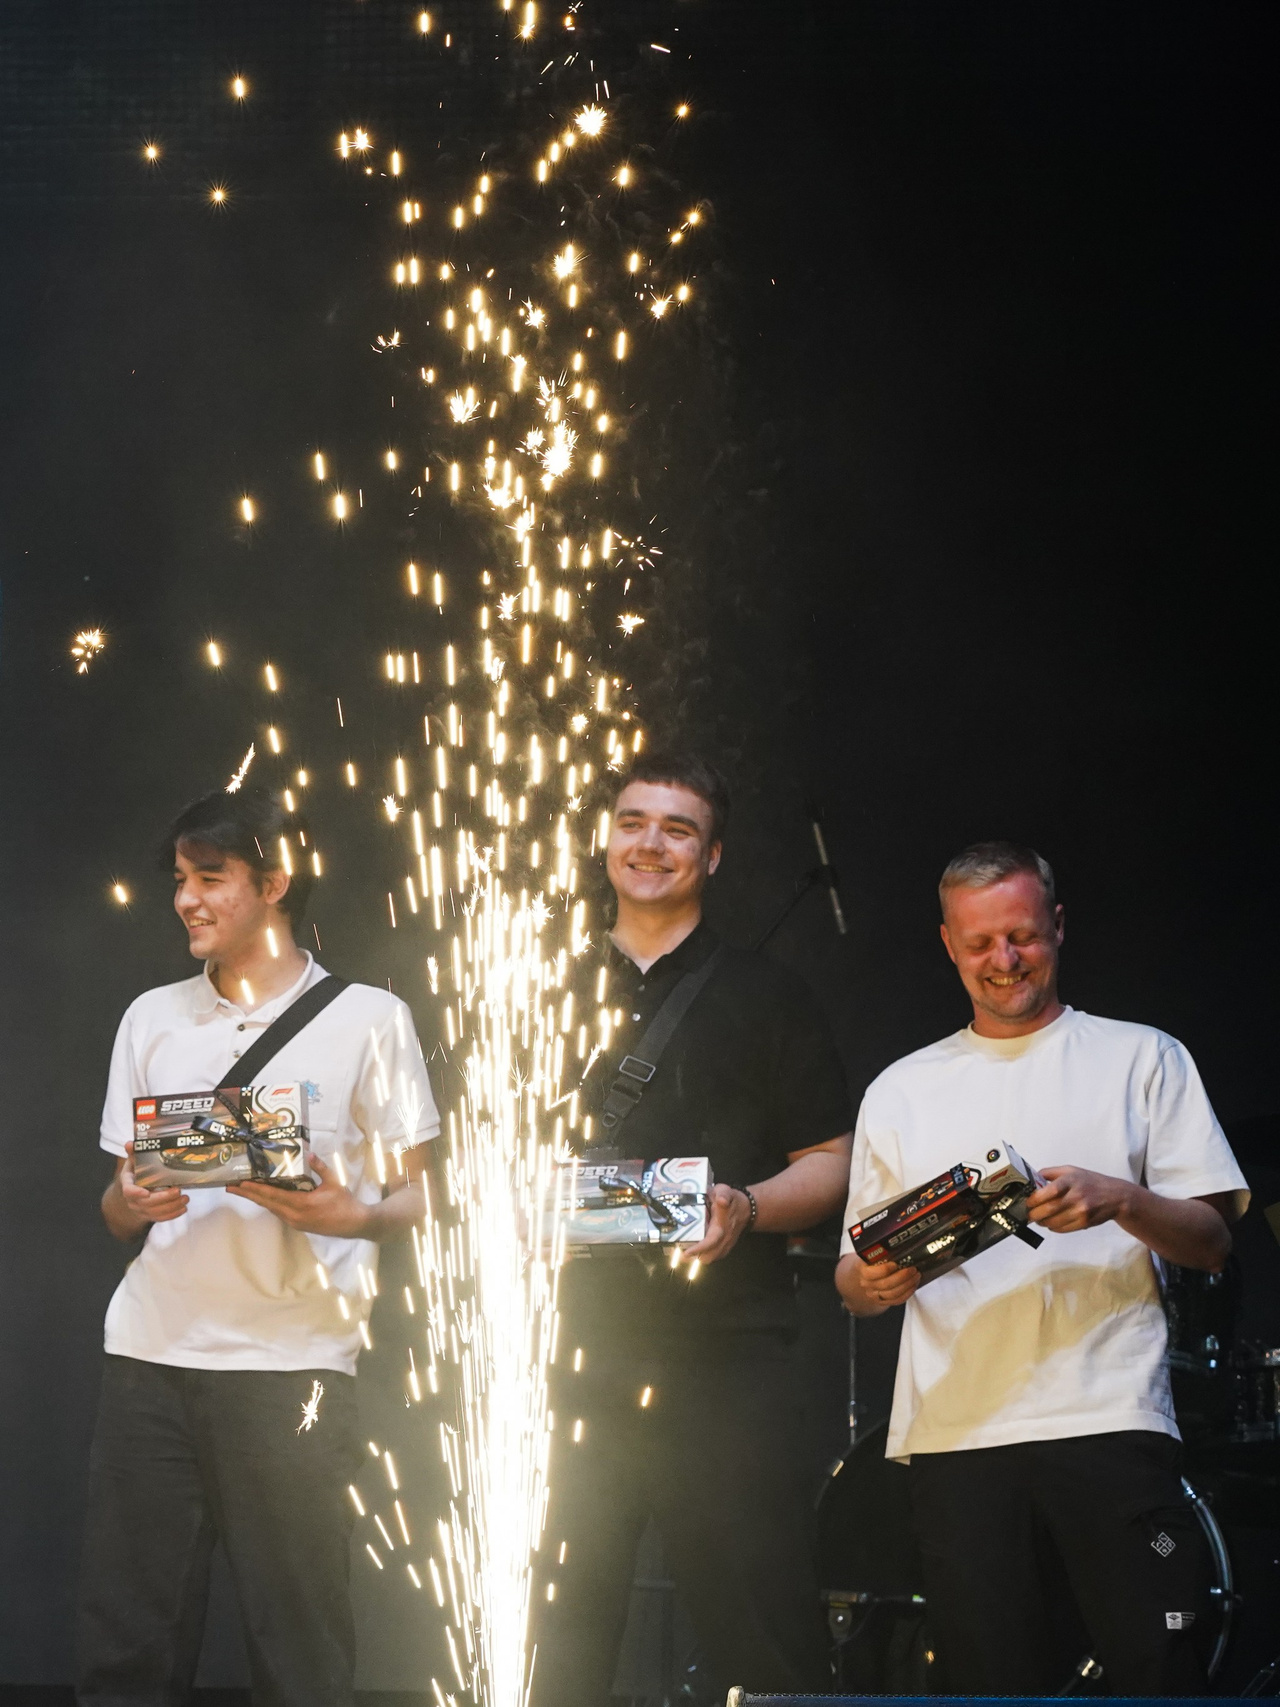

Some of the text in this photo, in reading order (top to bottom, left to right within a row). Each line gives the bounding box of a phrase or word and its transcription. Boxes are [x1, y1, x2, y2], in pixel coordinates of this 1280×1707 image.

[160, 1097, 215, 1112] SPEED
[137, 1123, 151, 1132] 10+
[134, 1139, 161, 1151] OKX
[176, 1135, 205, 1147] OKX
[867, 1246, 884, 1260] LEGO
[887, 1212, 939, 1247] SPEED
[926, 1234, 956, 1255] OKX
